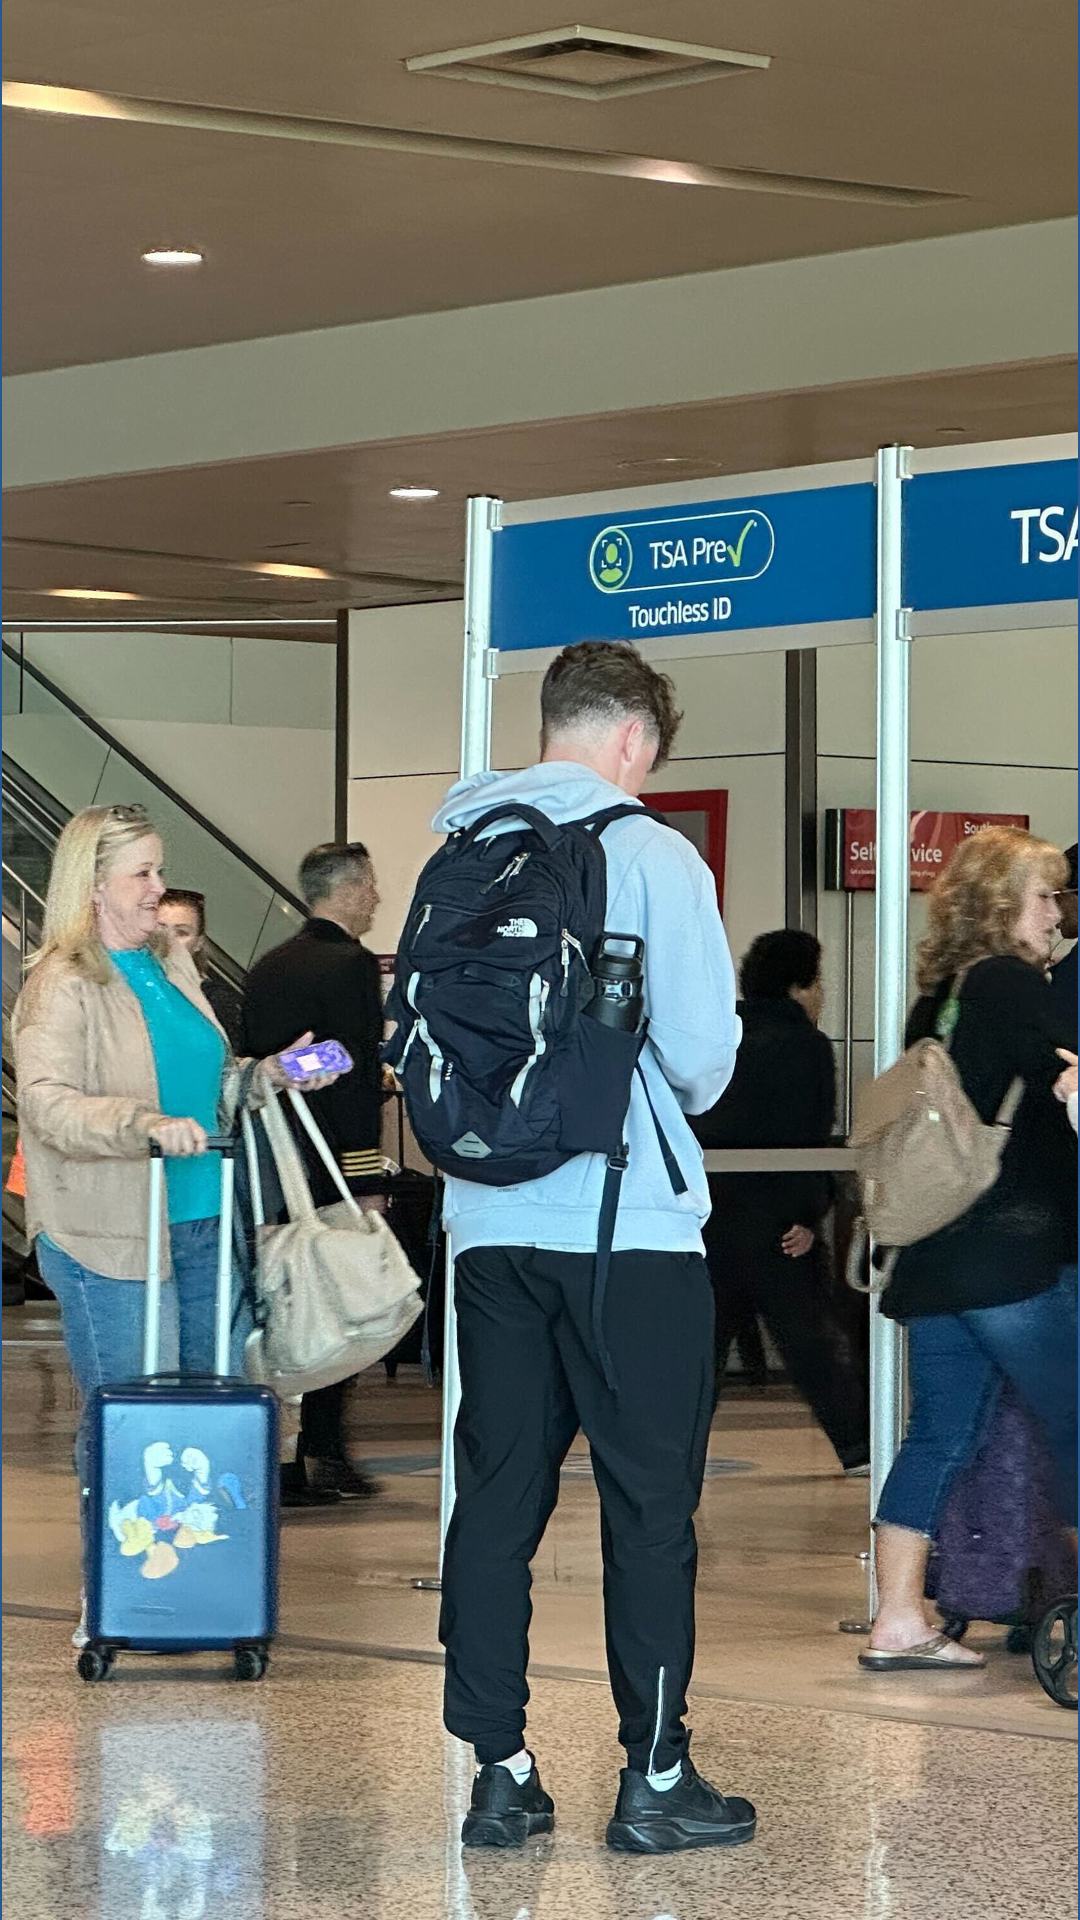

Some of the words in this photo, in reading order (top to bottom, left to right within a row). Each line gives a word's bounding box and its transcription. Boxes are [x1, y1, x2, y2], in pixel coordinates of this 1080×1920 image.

[649, 540, 688, 570] TSA
[693, 536, 727, 566] Pre
[628, 600, 709, 628] Touchless
[713, 597, 731, 620] ID
